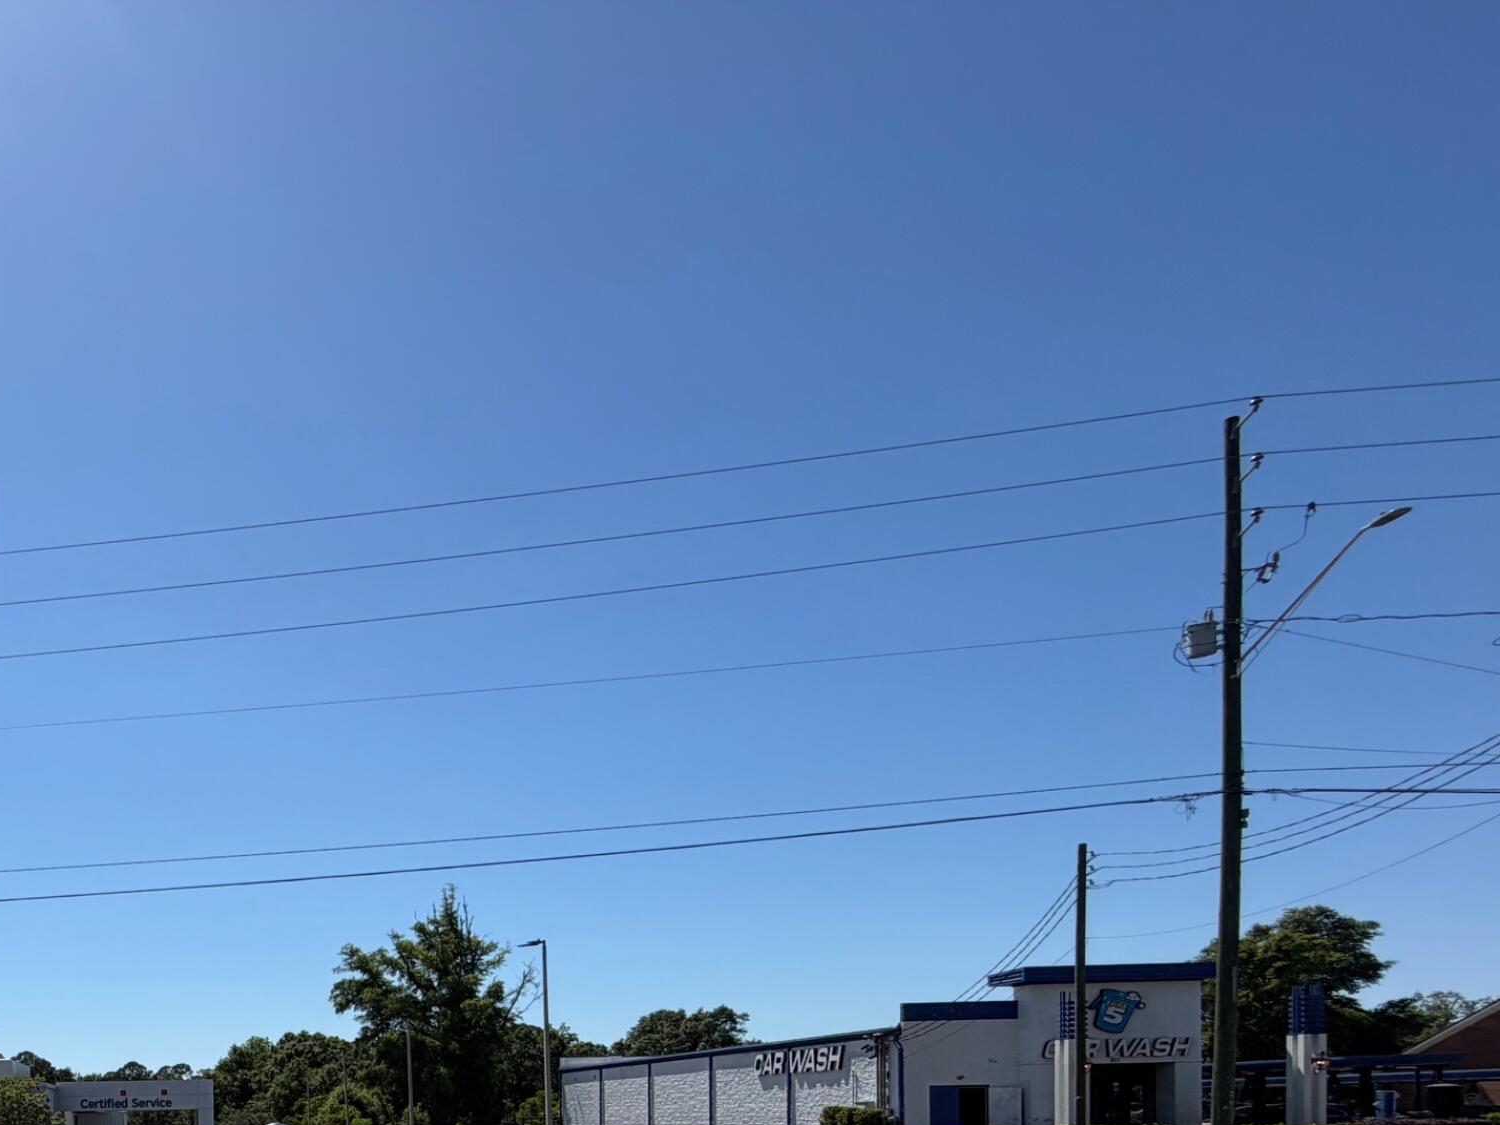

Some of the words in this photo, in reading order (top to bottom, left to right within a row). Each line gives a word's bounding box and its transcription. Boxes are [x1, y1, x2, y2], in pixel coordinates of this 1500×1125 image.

[1103, 1007, 1126, 1024] 5
[1042, 1038, 1100, 1060] CR
[1106, 1037, 1192, 1058] WASH
[753, 1051, 786, 1076] CAR
[789, 1045, 845, 1073] WASH
[80, 1098, 128, 1109] Certified
[131, 1098, 173, 1109] Service
